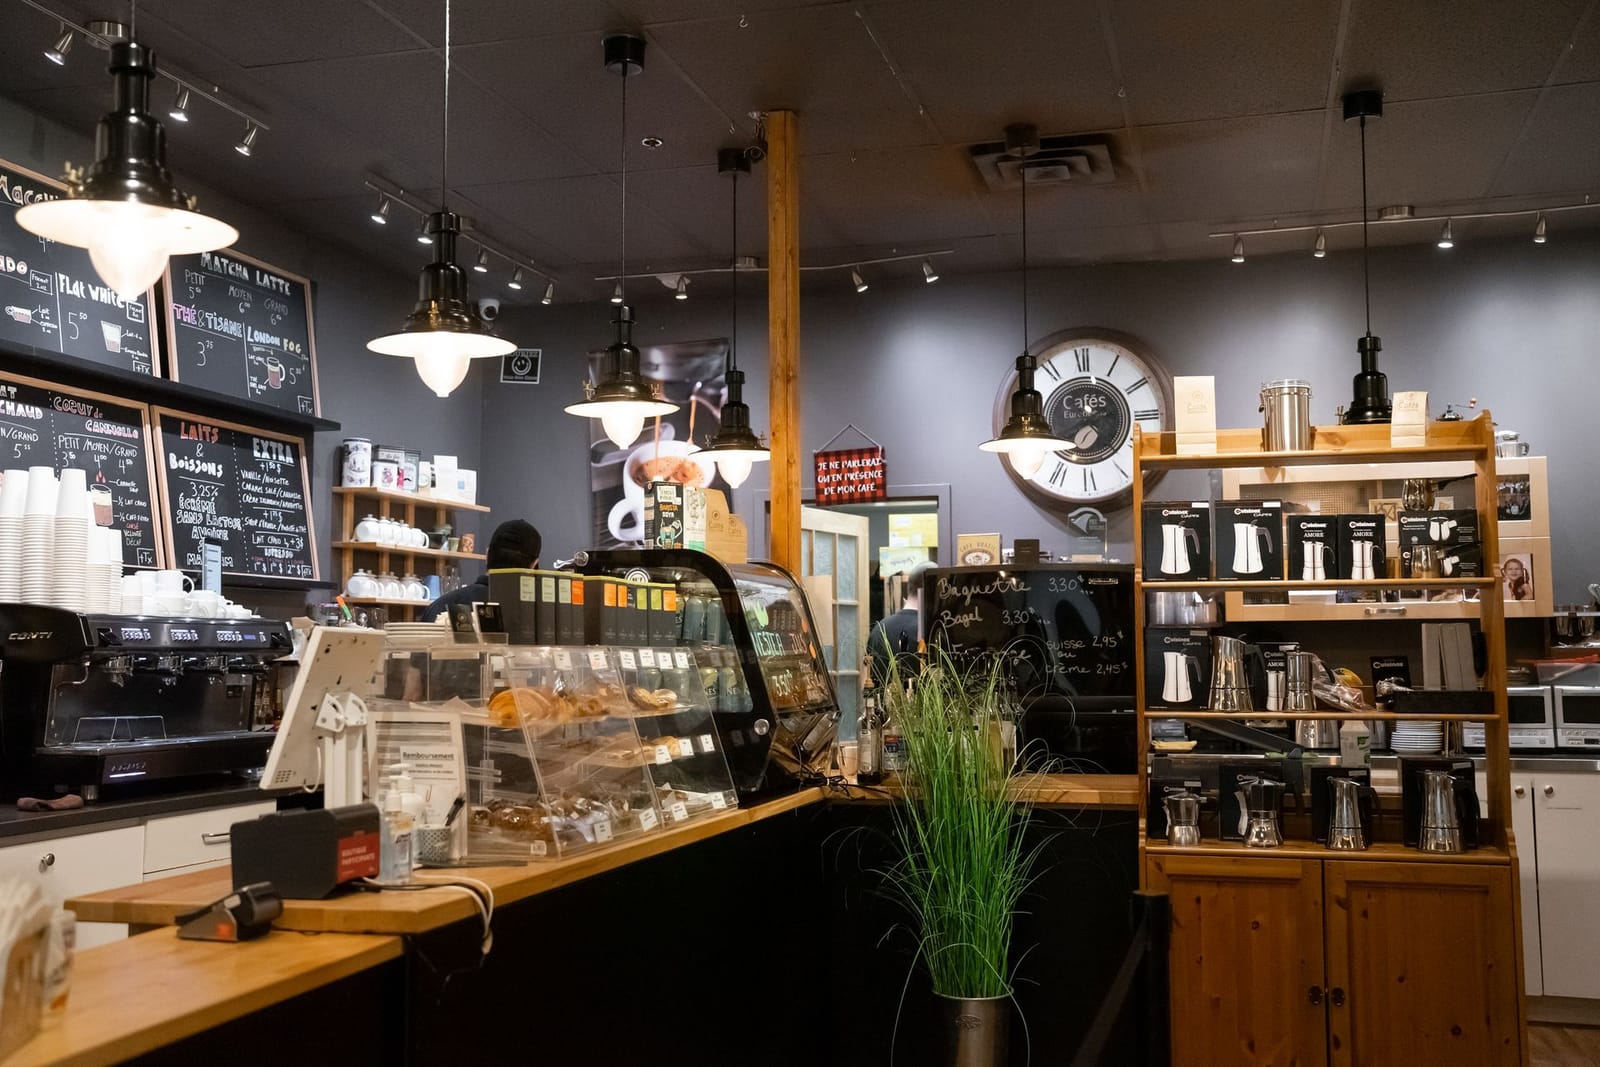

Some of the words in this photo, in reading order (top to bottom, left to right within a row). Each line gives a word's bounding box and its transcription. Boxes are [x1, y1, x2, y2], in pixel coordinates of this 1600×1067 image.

[256, 270, 291, 296] LATTE
[283, 338, 302, 354] FOG
[1063, 394, 1106, 410] Cafés
[180, 421, 219, 444] LAITS
[252, 437, 295, 464] EXTRA
[818, 462, 828, 471] JE
[829, 460, 840, 470] NE
[824, 487, 836, 496] DE
[837, 485, 856, 495] MON
[857, 482, 877, 493] CAFÉ
[937, 577, 1031, 606] Baguette
[941, 606, 983, 628] Bagel
[402, 751, 455, 760] Remboursement
